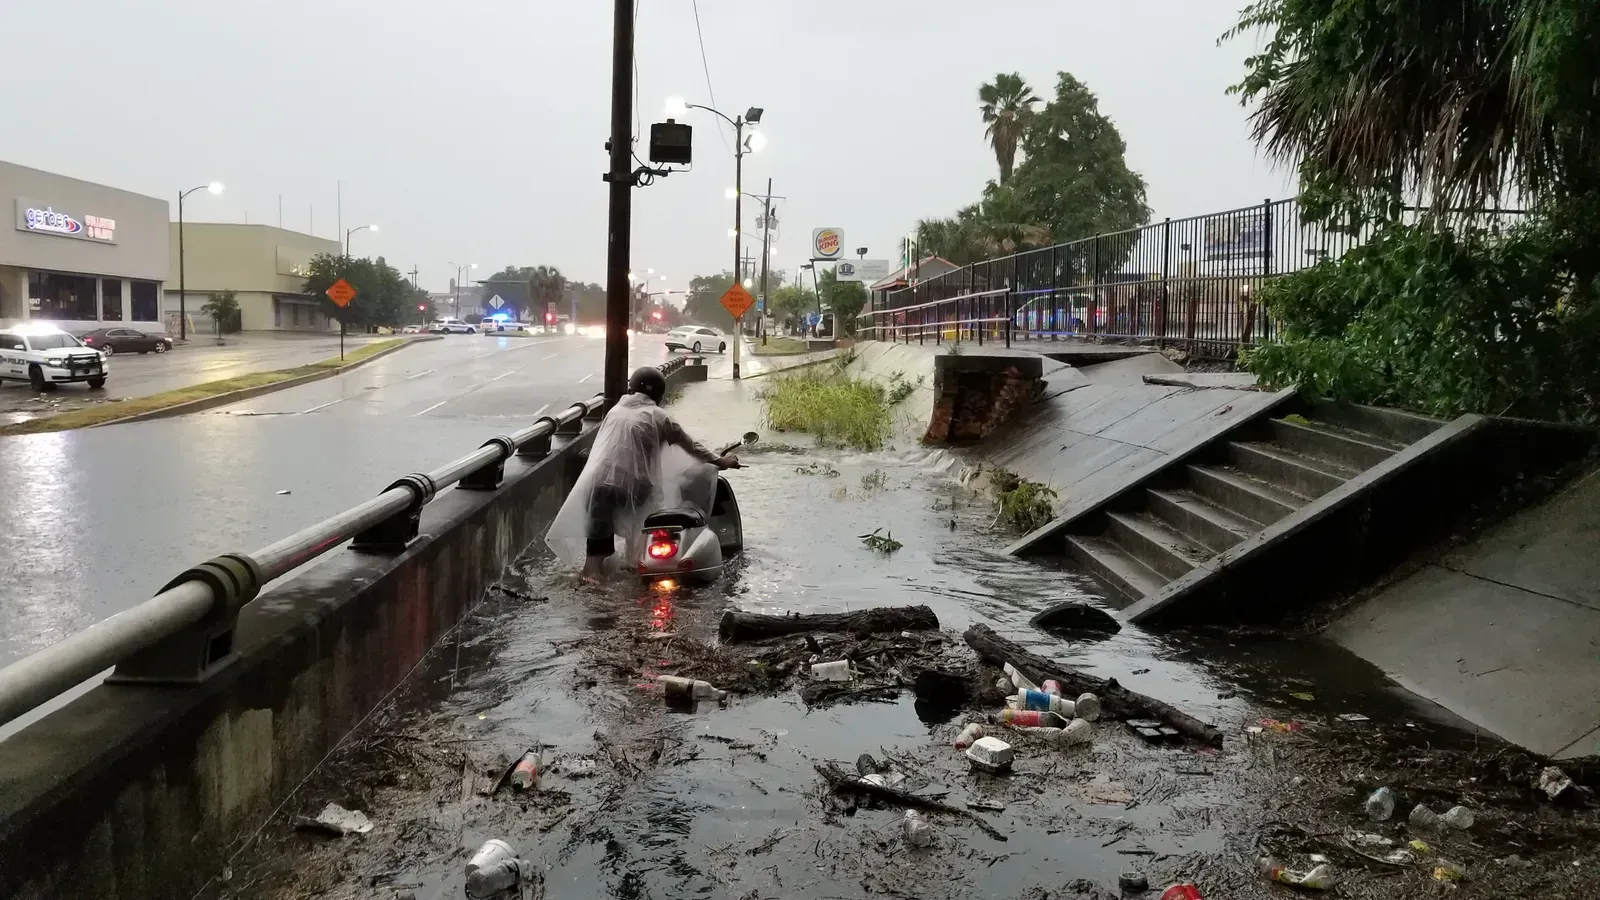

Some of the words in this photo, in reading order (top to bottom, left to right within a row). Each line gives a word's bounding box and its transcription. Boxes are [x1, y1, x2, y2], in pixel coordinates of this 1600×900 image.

[27, 207, 69, 229] gerber
[818, 235, 838, 244] BURGER
[819, 239, 839, 250] KING
